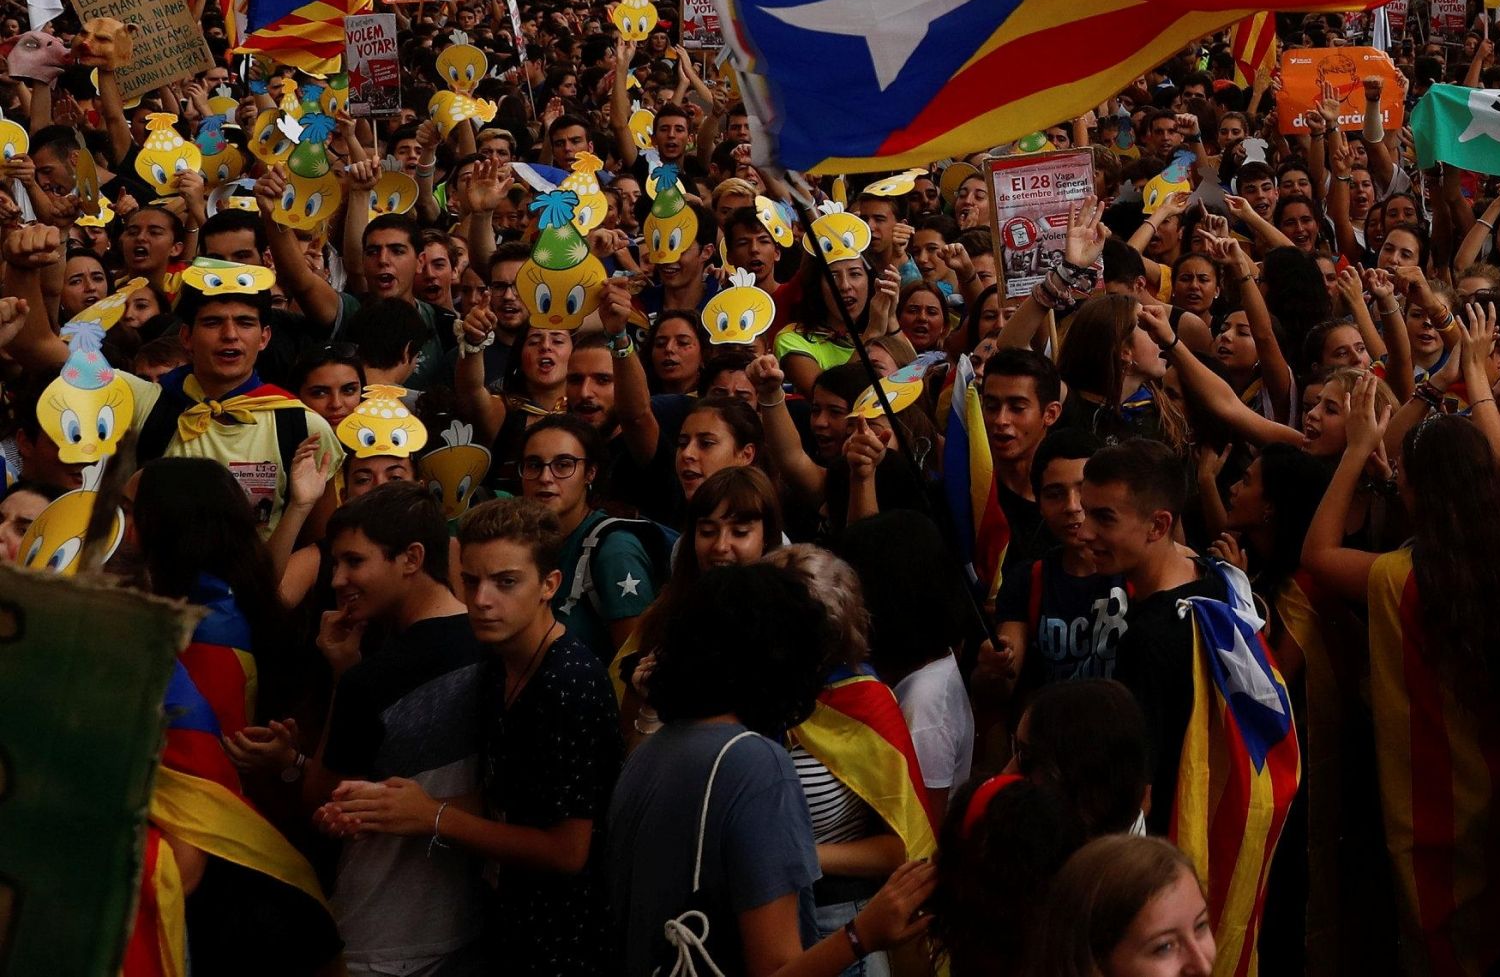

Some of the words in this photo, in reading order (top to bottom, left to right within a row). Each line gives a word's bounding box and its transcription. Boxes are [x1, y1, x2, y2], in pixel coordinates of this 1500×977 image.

[153, 8, 164, 19] NI
[165, 0, 185, 15] AMB
[1439, 4, 1465, 13] VOTAR!
[143, 24, 154, 34] NI
[156, 21, 173, 33] EL
[166, 26, 192, 42] AMB
[346, 24, 384, 45] VOLEM
[357, 37, 397, 59] VOTAR!
[1012, 177, 1026, 192] El
[1030, 175, 1050, 190] 28
[1055, 173, 1075, 181] Vaga
[1056, 178, 1088, 189] General
[999, 194, 1010, 202] de
[1012, 190, 1052, 200] setembre
